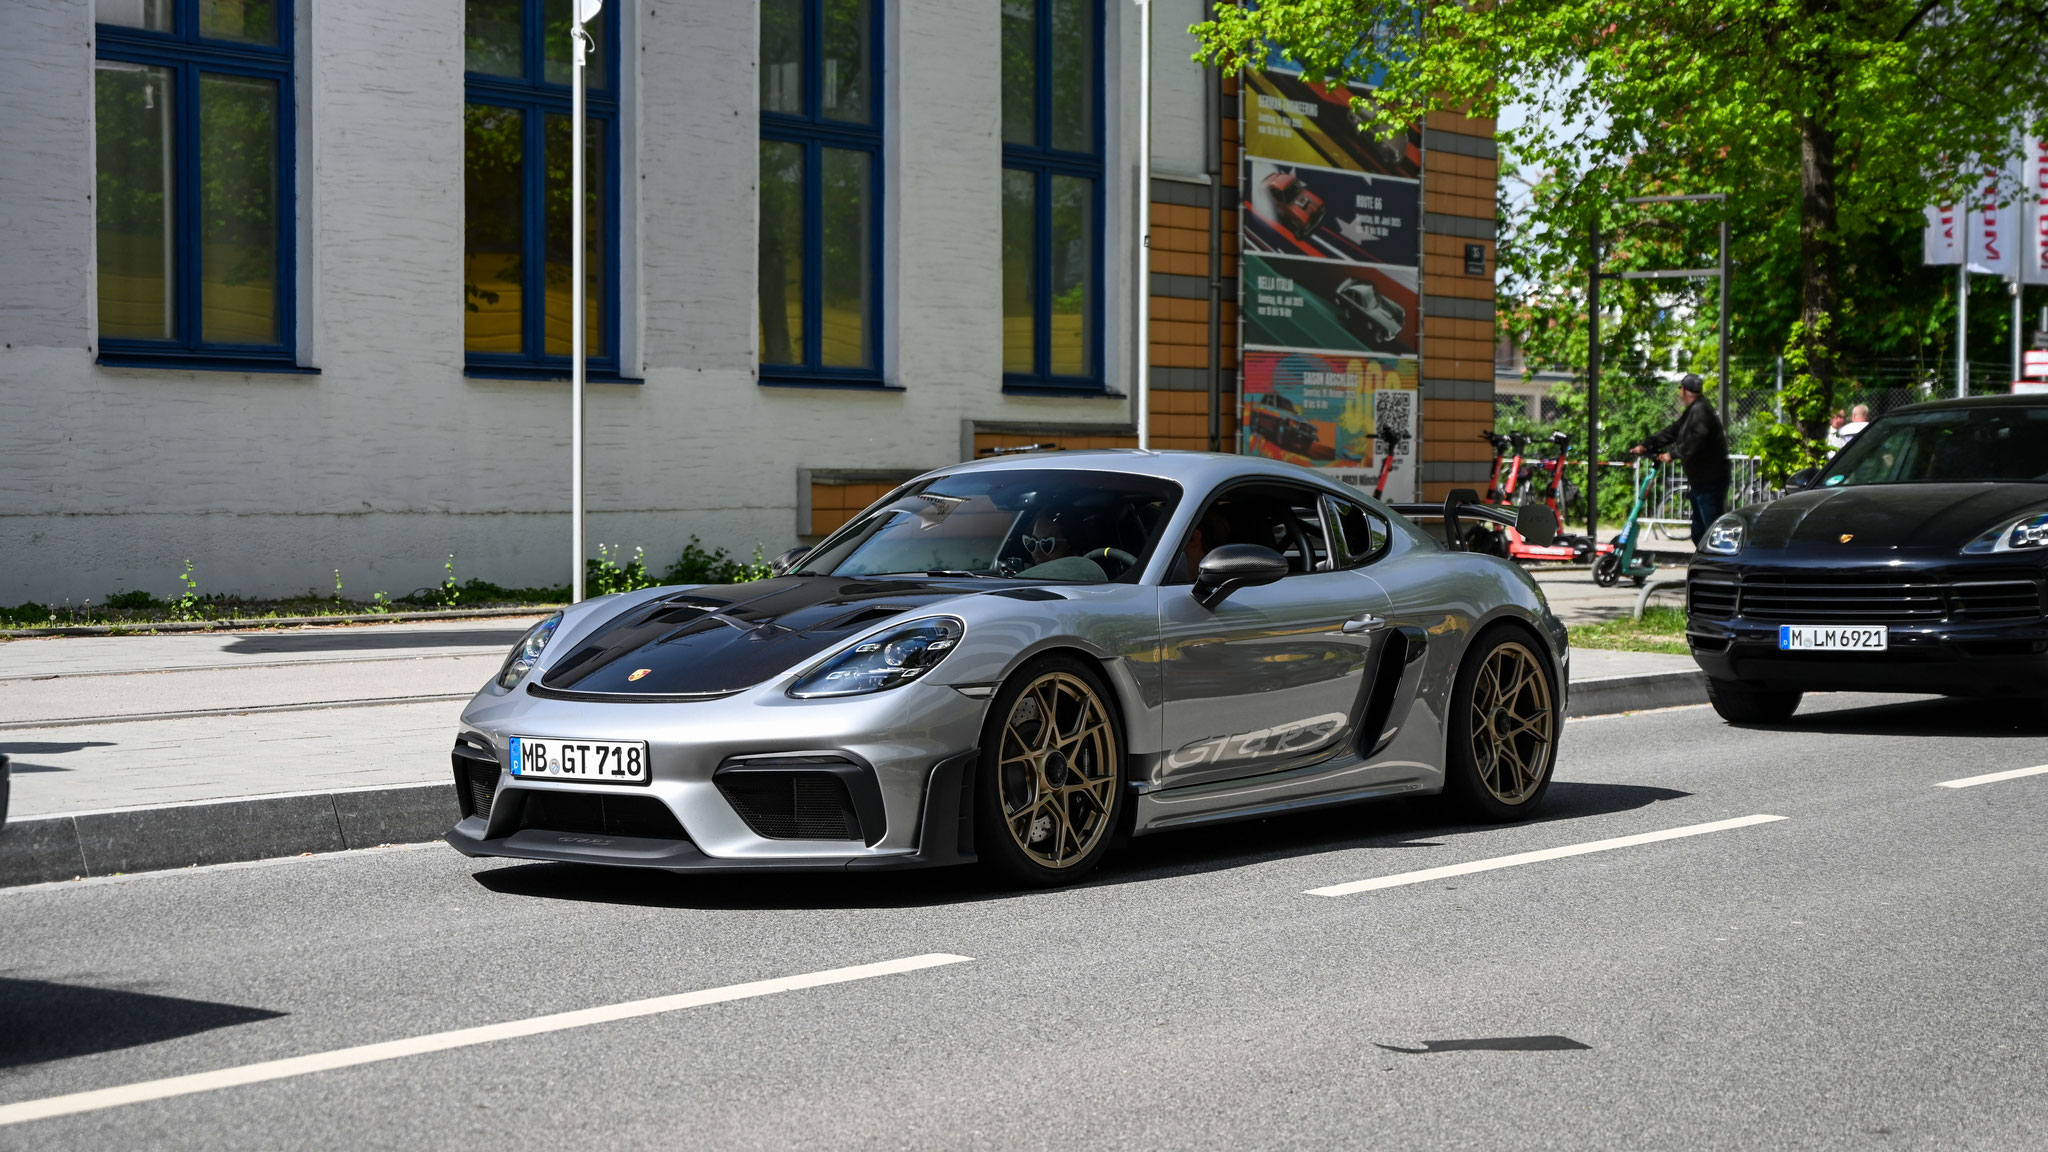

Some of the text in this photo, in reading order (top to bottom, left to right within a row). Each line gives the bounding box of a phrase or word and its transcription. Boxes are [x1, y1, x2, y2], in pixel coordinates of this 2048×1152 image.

[1356, 195, 1382, 210] ROUTE 66
[1258, 276, 1294, 292] BELLA ITALIA
[1304, 372, 1324, 385] SAISON
[1791, 629, 1884, 648] M LM 6921
[522, 743, 641, 776] MB GT 718
